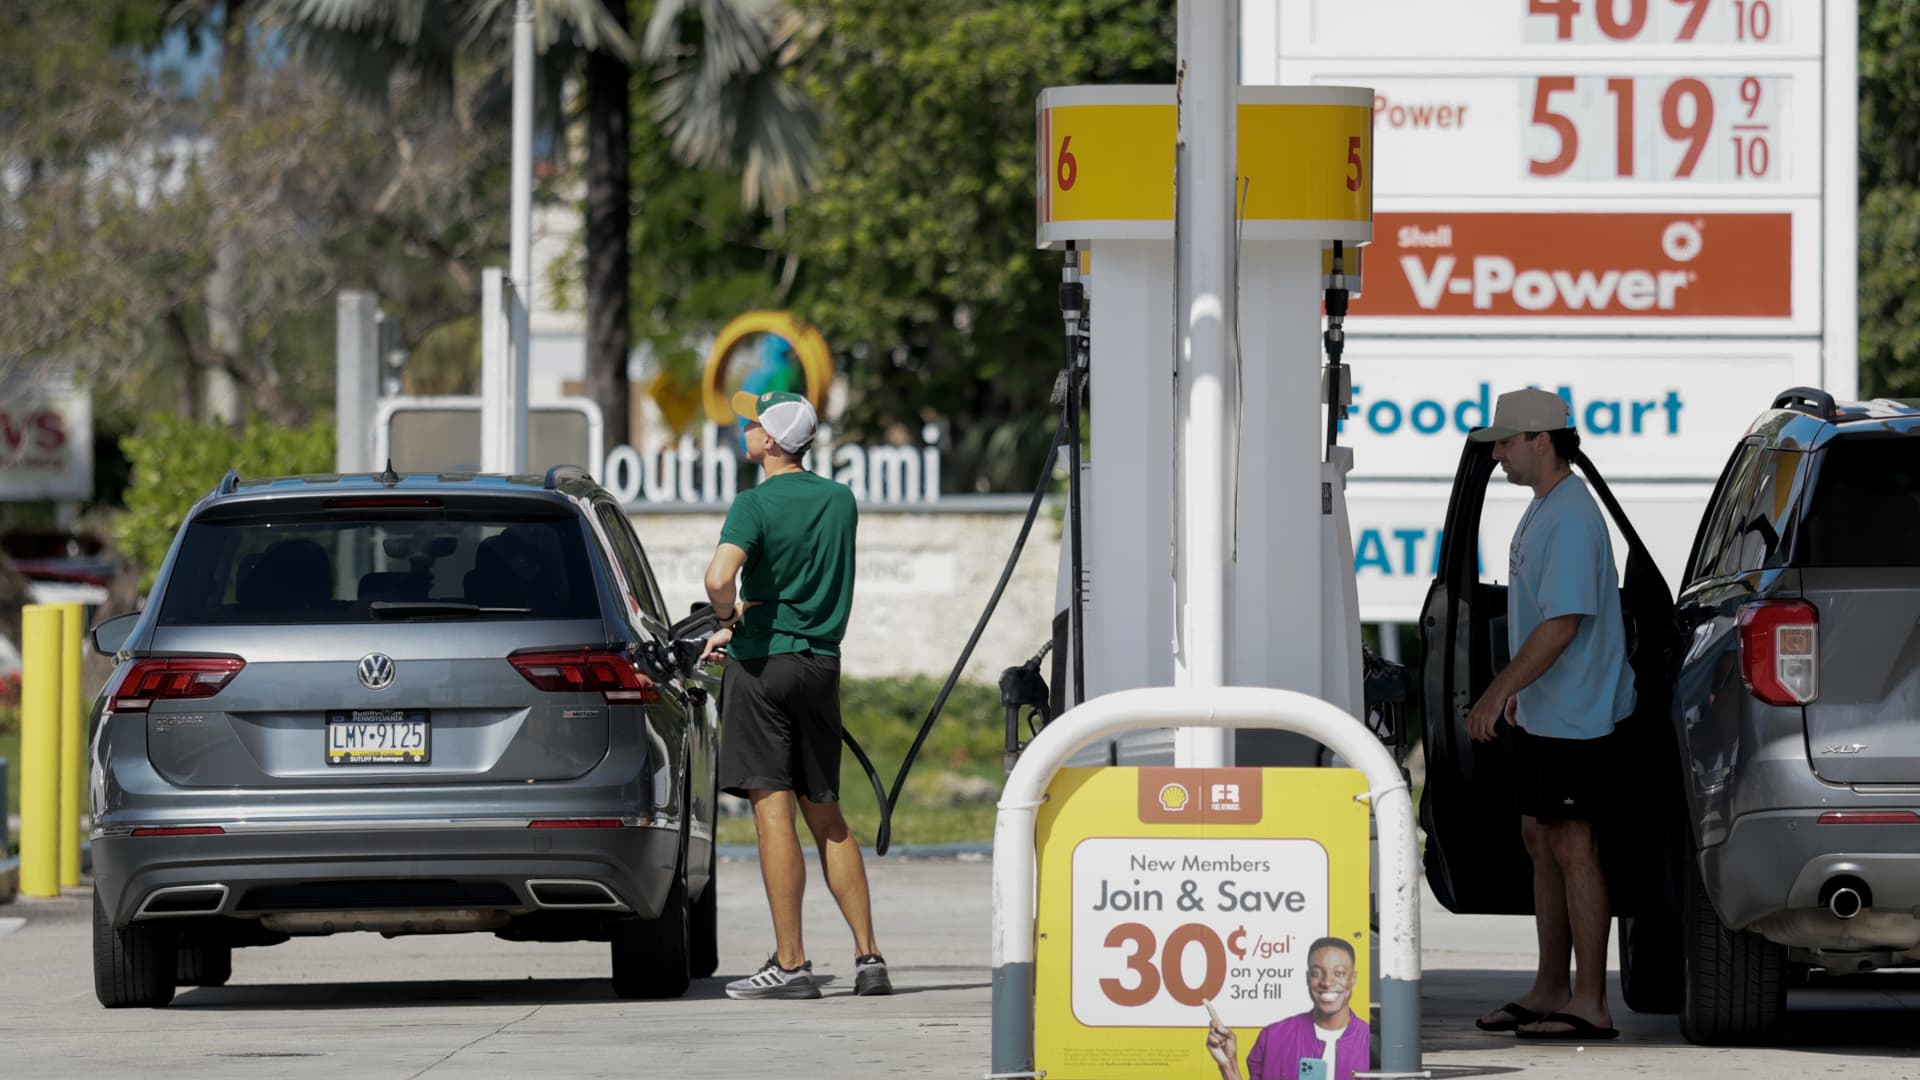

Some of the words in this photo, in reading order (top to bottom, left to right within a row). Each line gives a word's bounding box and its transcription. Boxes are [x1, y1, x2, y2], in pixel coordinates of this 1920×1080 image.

[1740, 76, 1761, 118] 9
[1528, 76, 1714, 178] 519
[1057, 136, 1077, 191] 6
[1346, 136, 1363, 192] 5
[1732, 137, 1769, 177] 10
[1397, 226, 1452, 248] Shell
[1400, 255, 1688, 310] V-Power
[604, 421, 737, 502] outh
[757, 423, 941, 502] iami
[1821, 744, 1868, 754] XLT
[1131, 855, 1175, 872] New
[1182, 854, 1270, 872] Members
[1092, 879, 1163, 912] Join
[1176, 880, 1205, 912] &
[1217, 880, 1306, 912] Save
[1230, 967, 1251, 979] on
[1257, 967, 1294, 983] your
[1230, 984, 1258, 1000] 3rd
[1263, 984, 1282, 1000] fill
